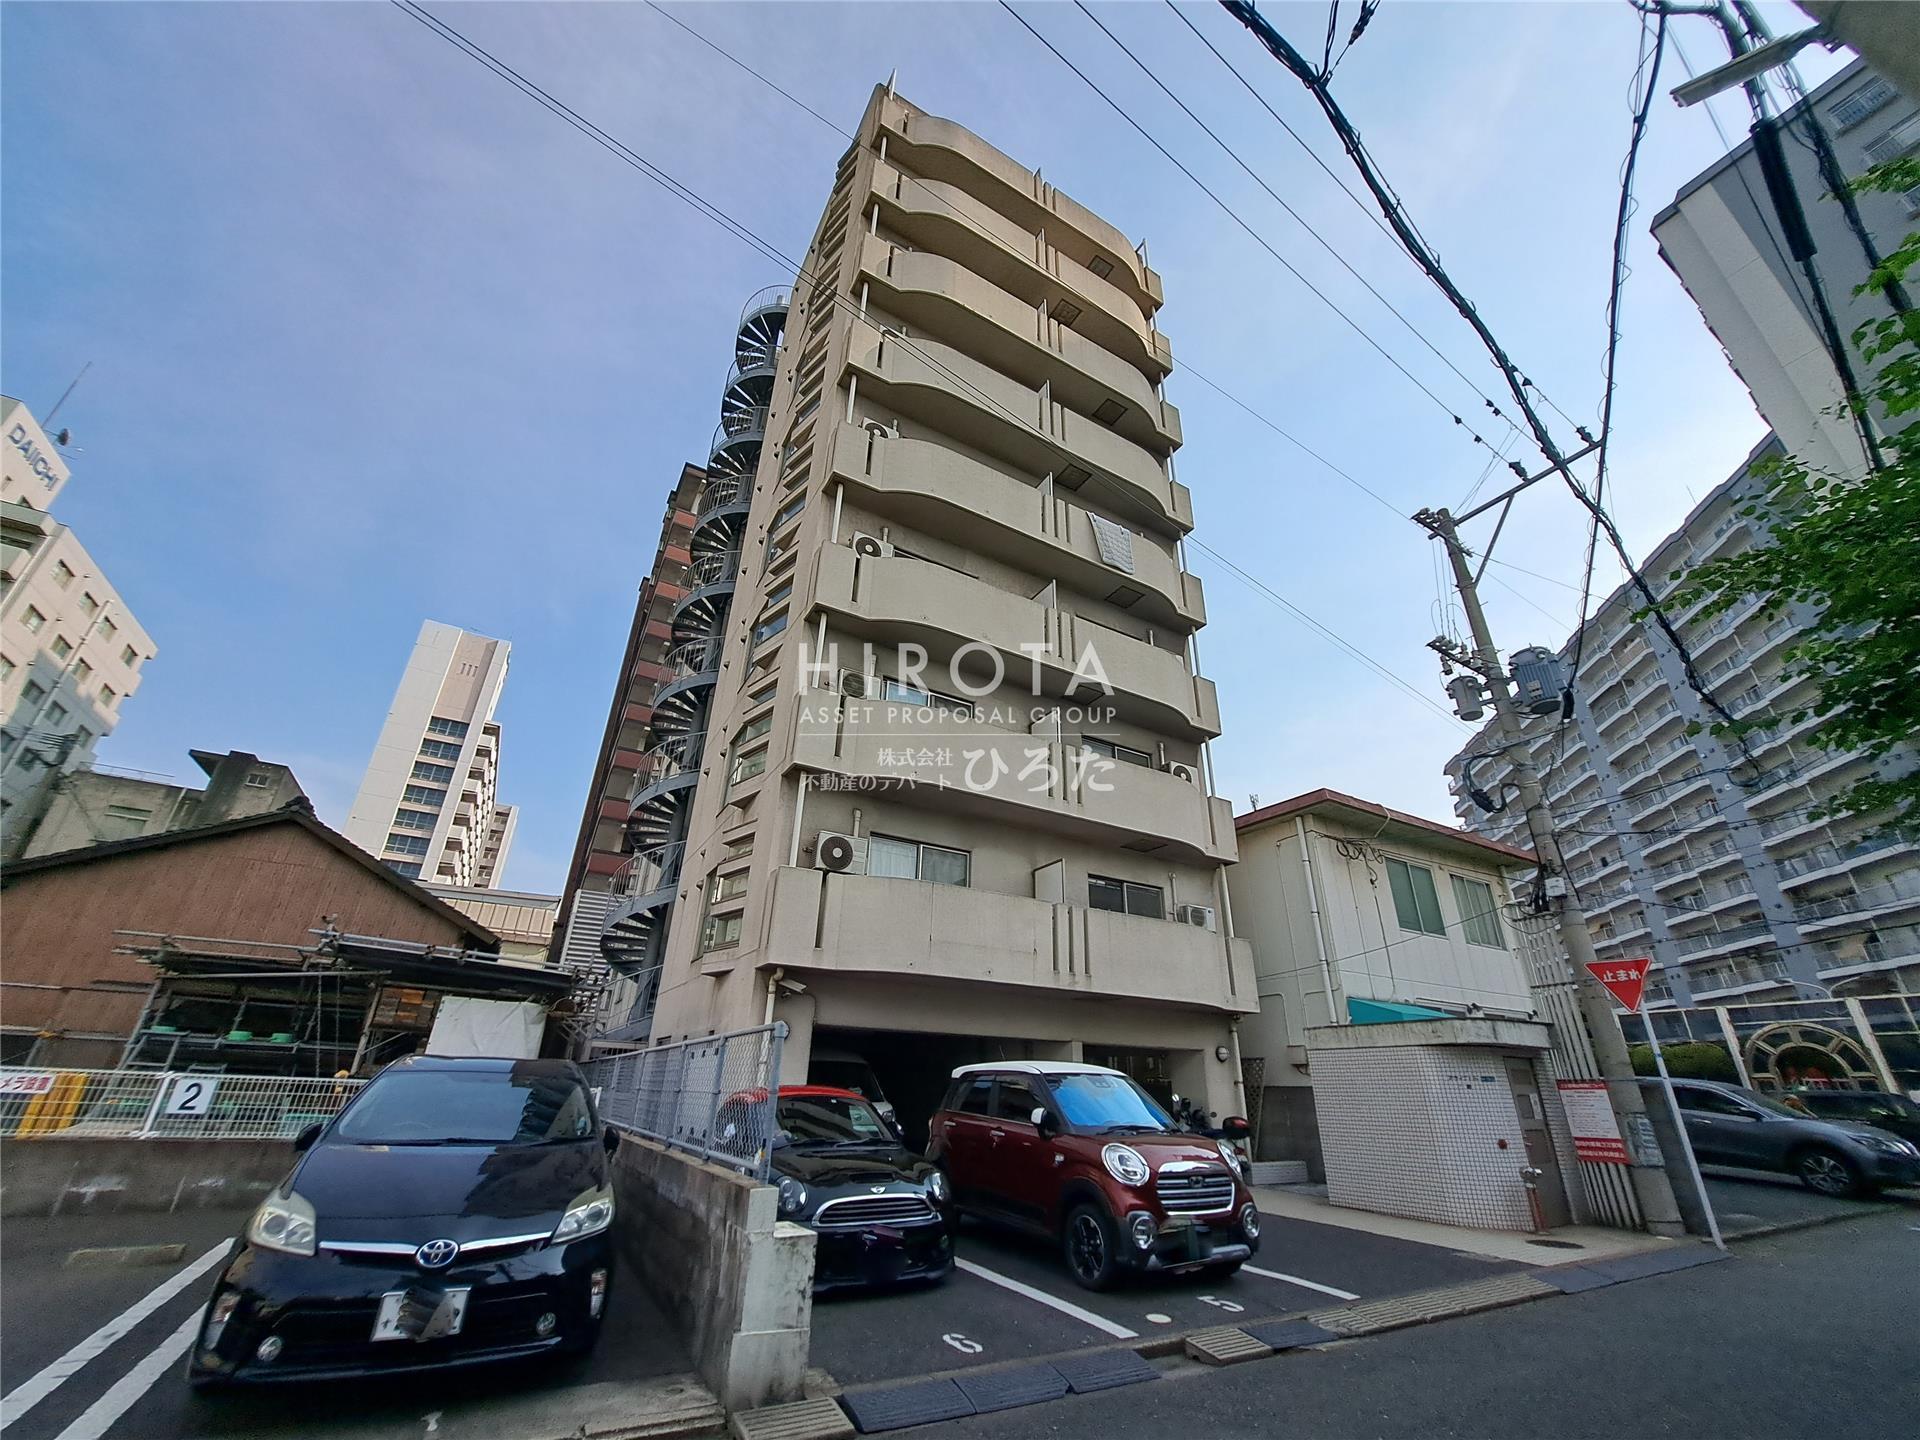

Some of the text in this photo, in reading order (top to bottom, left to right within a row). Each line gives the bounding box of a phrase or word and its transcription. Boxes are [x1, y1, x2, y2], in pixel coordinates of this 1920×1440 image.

[7, 422, 61, 492] DAIICHI
[1602, 968, 1642, 983] 止まれ
[178, 1082, 203, 1111] 2
[1196, 1295, 1245, 1312] 5
[942, 1333, 983, 1354] 6
